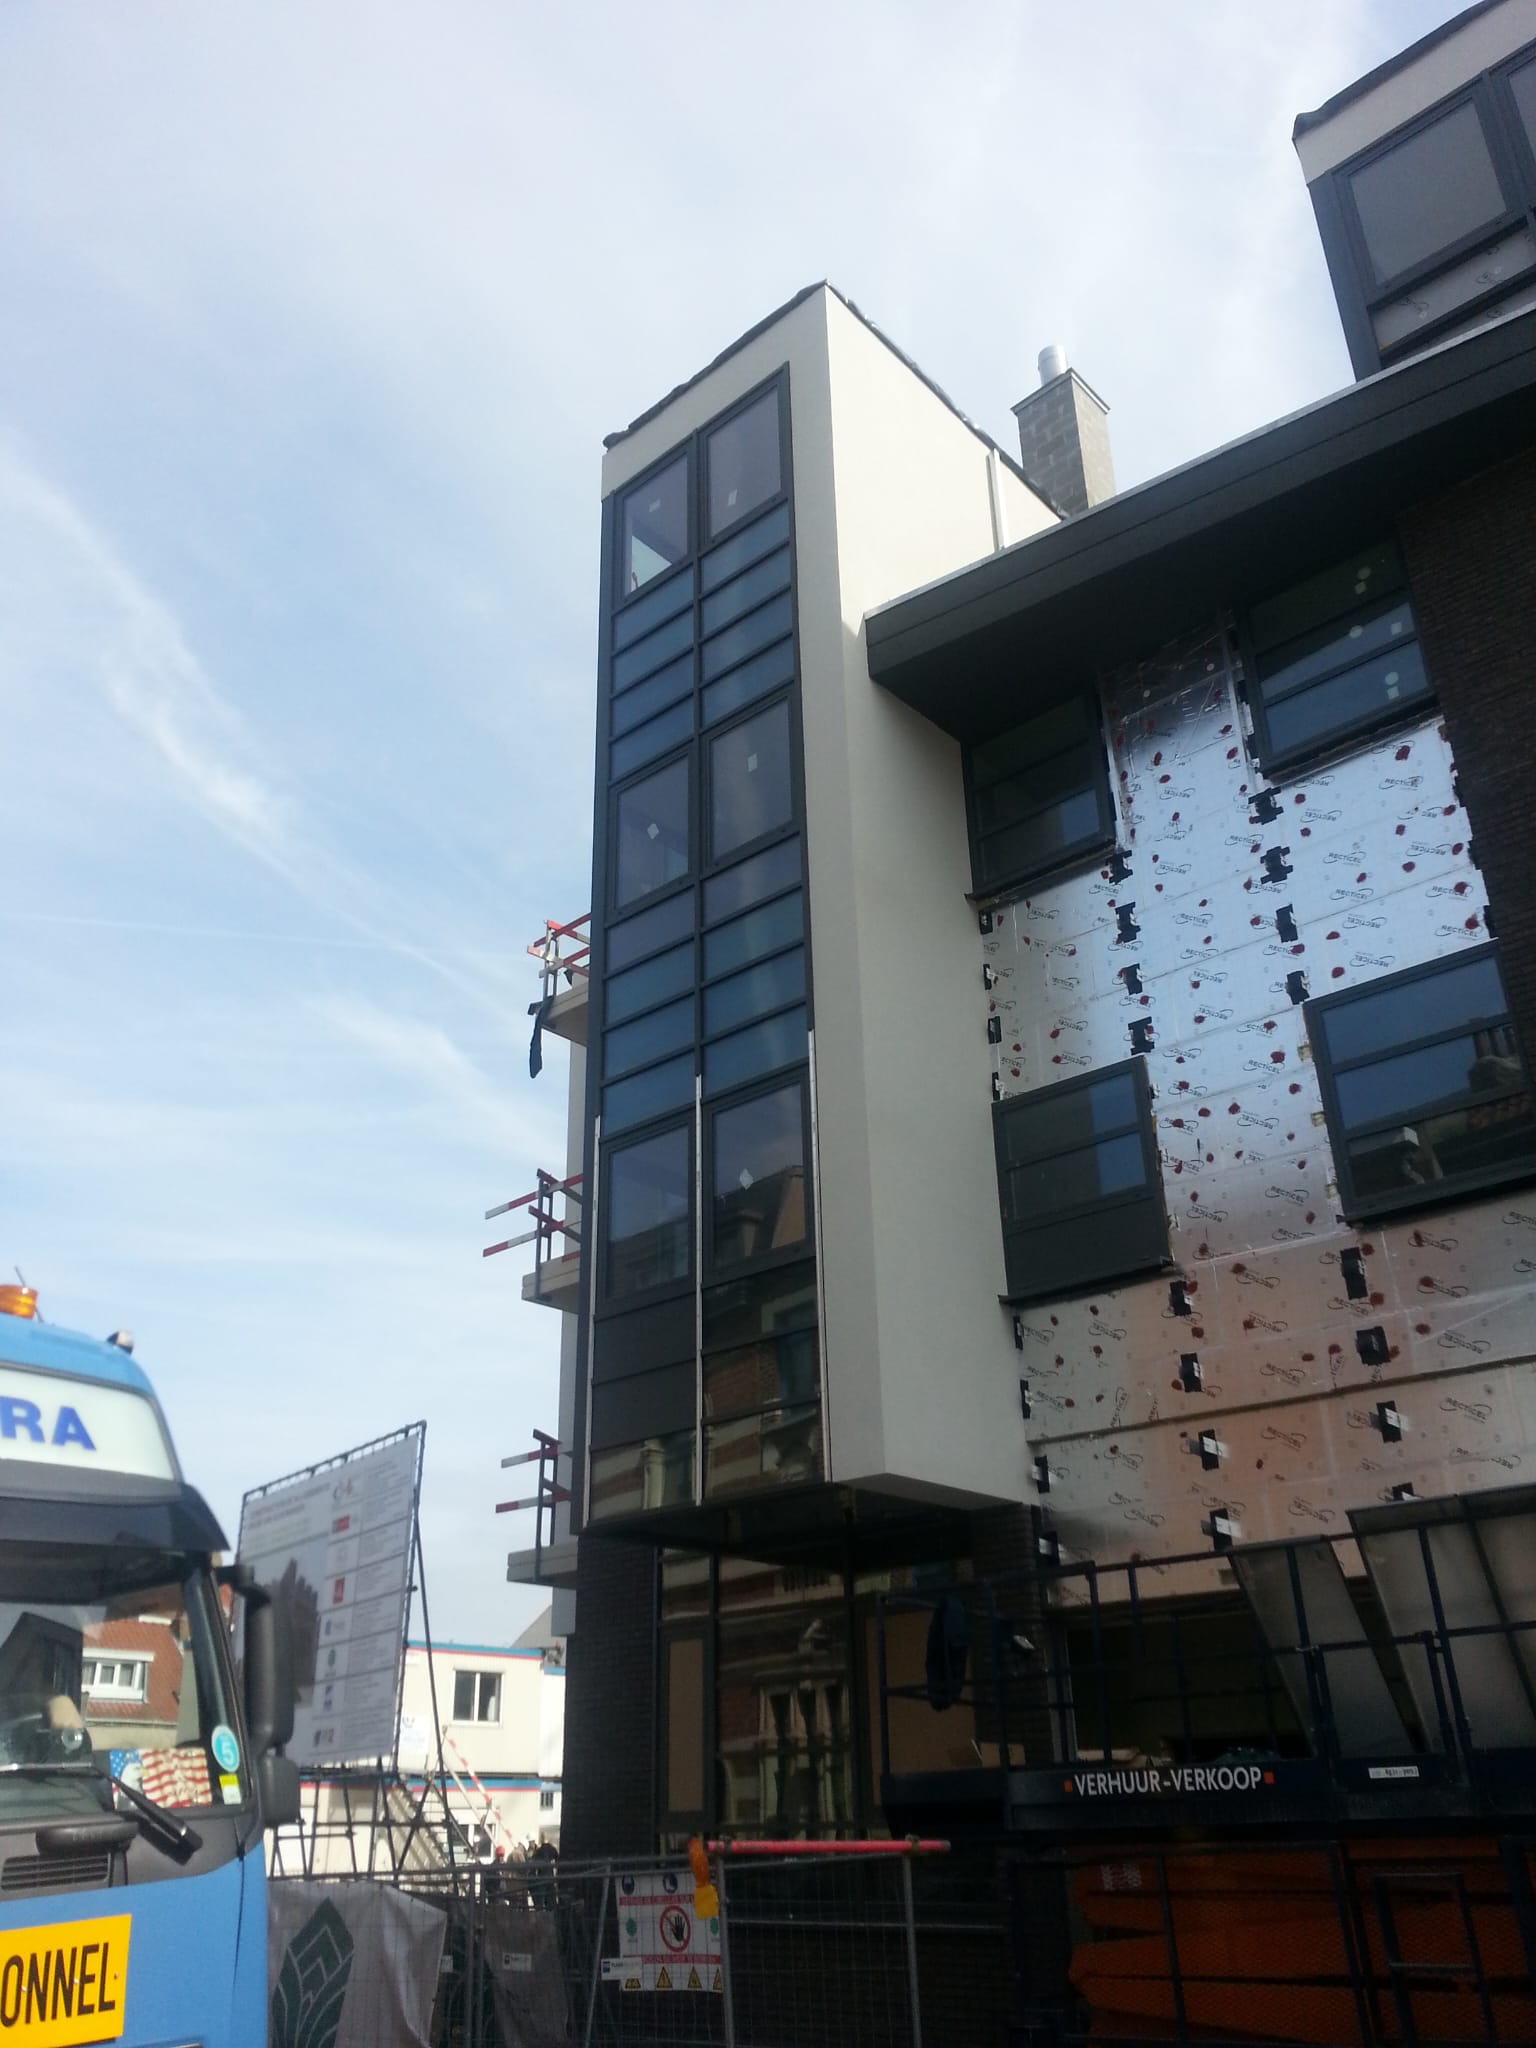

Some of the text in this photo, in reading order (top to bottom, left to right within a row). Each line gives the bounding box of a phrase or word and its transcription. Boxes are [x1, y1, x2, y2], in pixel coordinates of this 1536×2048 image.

[1328, 852, 1362, 863] RECTICEL
[1335, 889, 1368, 899] RECTICEL
[1347, 917, 1381, 928] RECTICEL
[0, 1396, 97, 1453] RA
[1074, 1766, 1263, 1797] VERHUUR-VERKOOP
[0, 1942, 116, 2029] ONNEL
